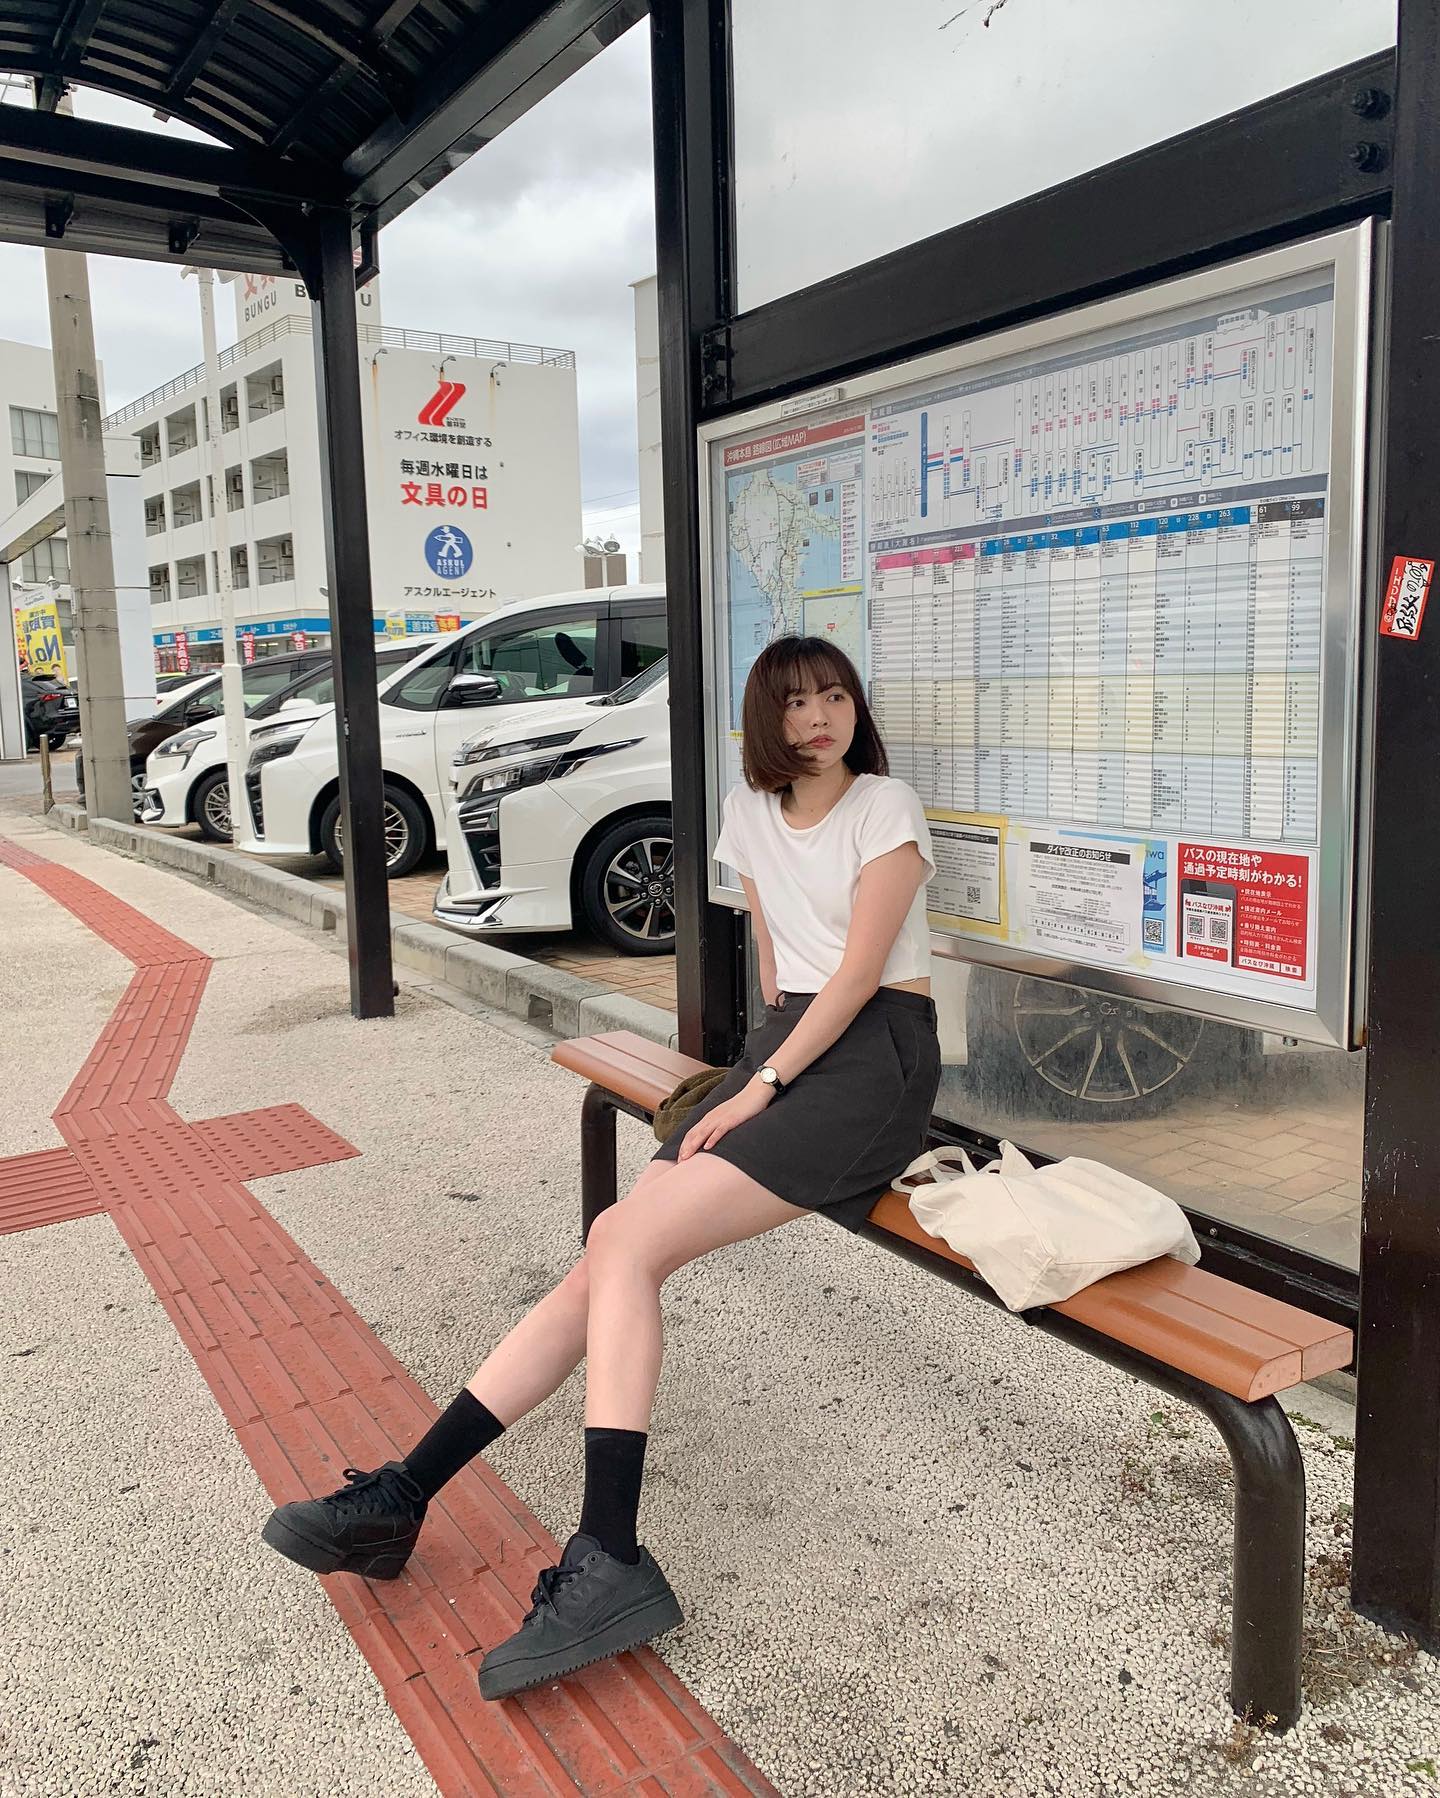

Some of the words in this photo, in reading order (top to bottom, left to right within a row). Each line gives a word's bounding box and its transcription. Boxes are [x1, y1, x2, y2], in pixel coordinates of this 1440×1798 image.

[244, 290, 277, 322] BUNGU
[393, 429, 493, 448] オフィス環境を創造する
[400, 458, 488, 480] 毎週水曜日は
[400, 480, 488, 510] 文具の日
[1218, 510, 1231, 518] 263
[437, 558, 465, 567] ASKUL
[437, 566, 465, 576] AGENT
[403, 586, 497, 599] アスクルエージェント
[1047, 844, 1112, 862] ダイヤ改正のお知らせ
[1184, 847, 1262, 867] バスの現在地や
[1191, 900, 1224, 912] バスなび沖縄
